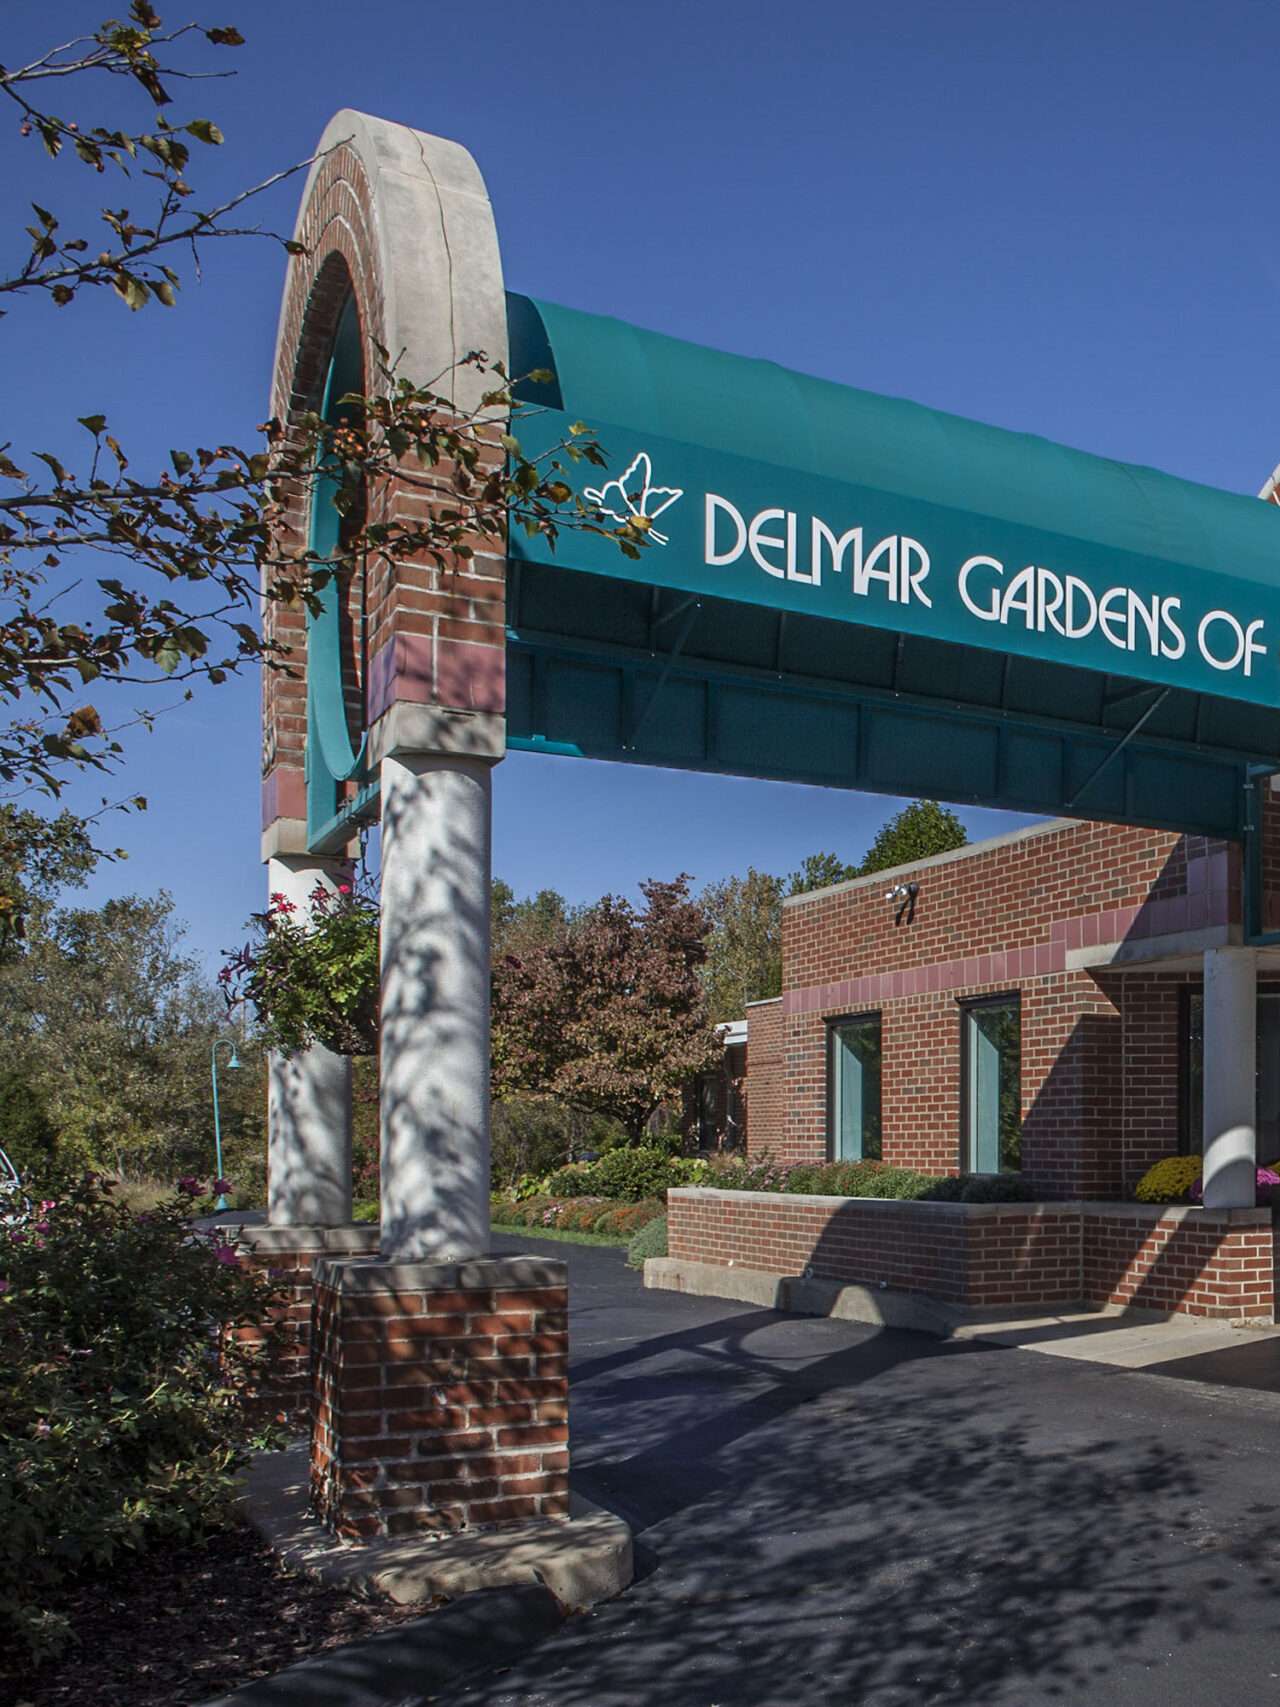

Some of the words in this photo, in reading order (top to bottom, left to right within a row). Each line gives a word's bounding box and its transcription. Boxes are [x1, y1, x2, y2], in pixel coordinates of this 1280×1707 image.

[704, 492, 933, 610] DELMAR
[957, 554, 1187, 661] GARDENS
[1197, 609, 1268, 677] OF
